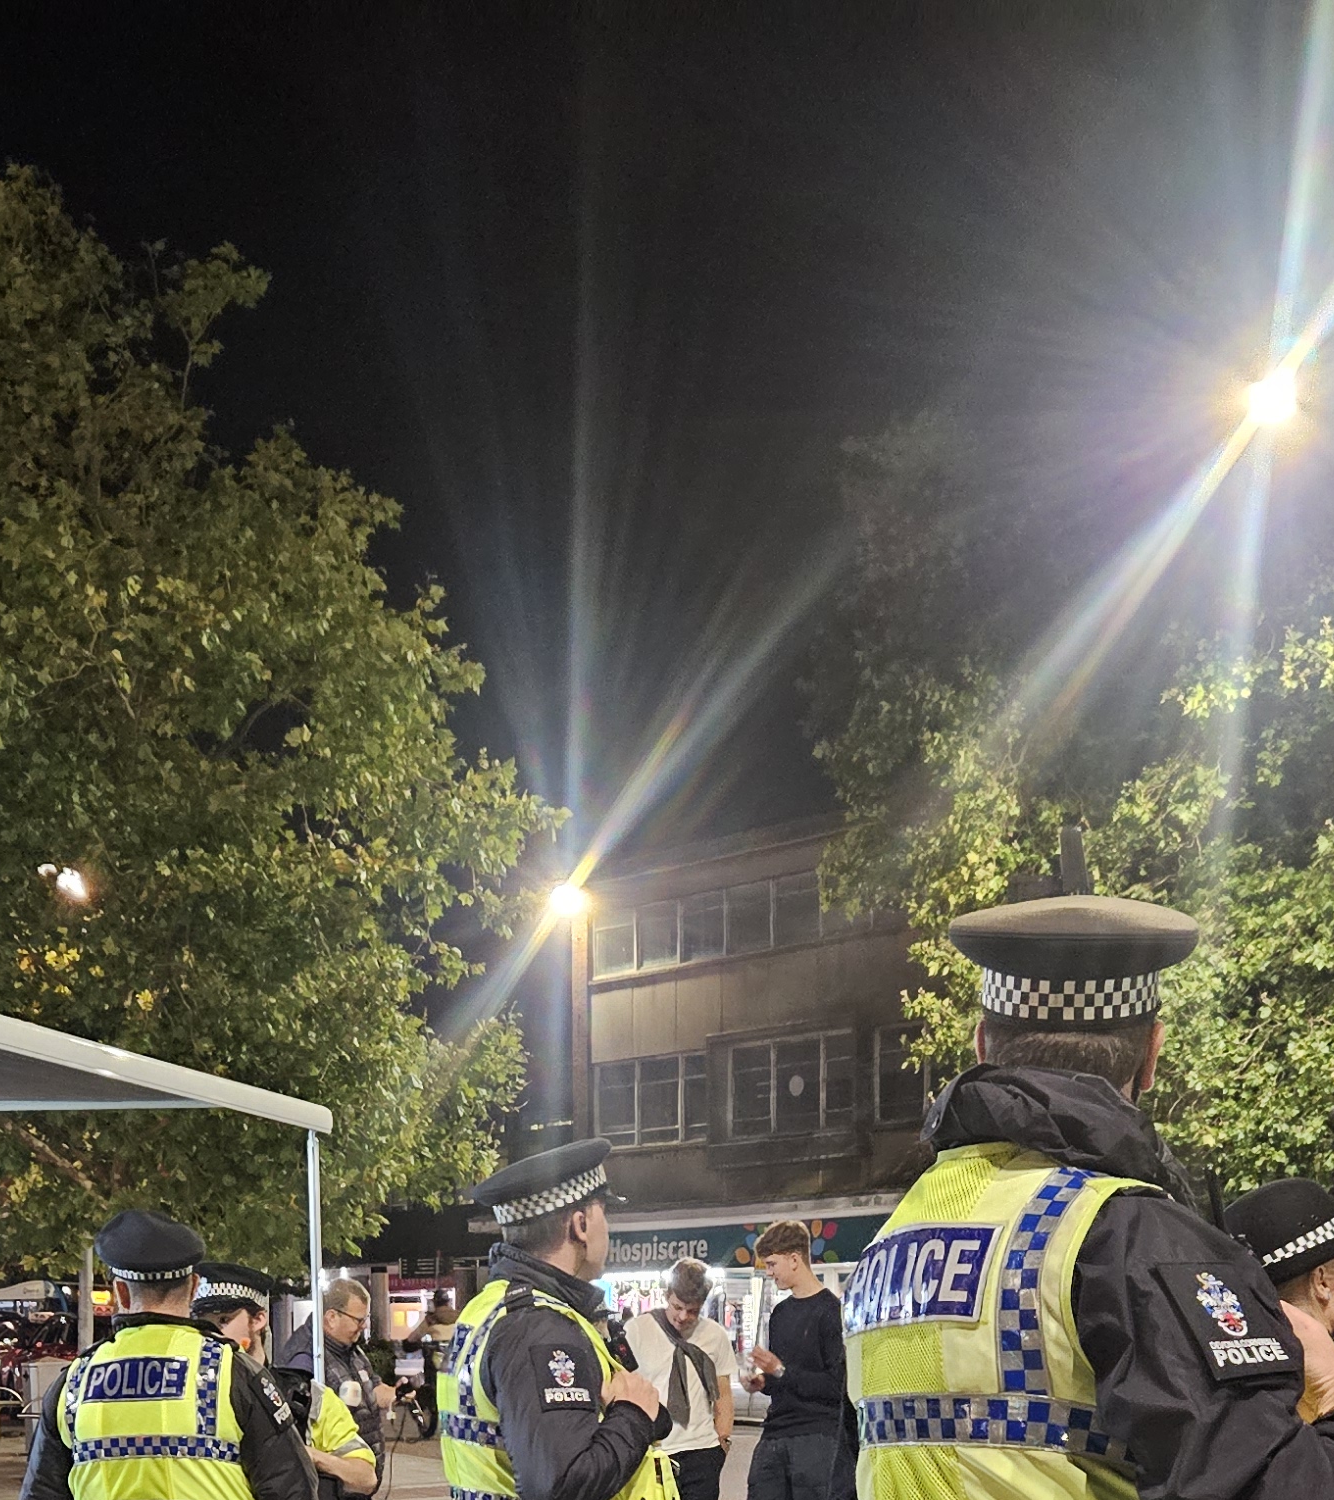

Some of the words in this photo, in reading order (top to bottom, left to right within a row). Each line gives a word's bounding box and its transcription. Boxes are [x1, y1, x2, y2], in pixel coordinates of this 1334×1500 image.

[609, 1235, 708, 1268] Hospiscare
[845, 1238, 981, 1317] POLICE
[1212, 1345, 1290, 1368] POLICE
[87, 1360, 181, 1398] POLICE
